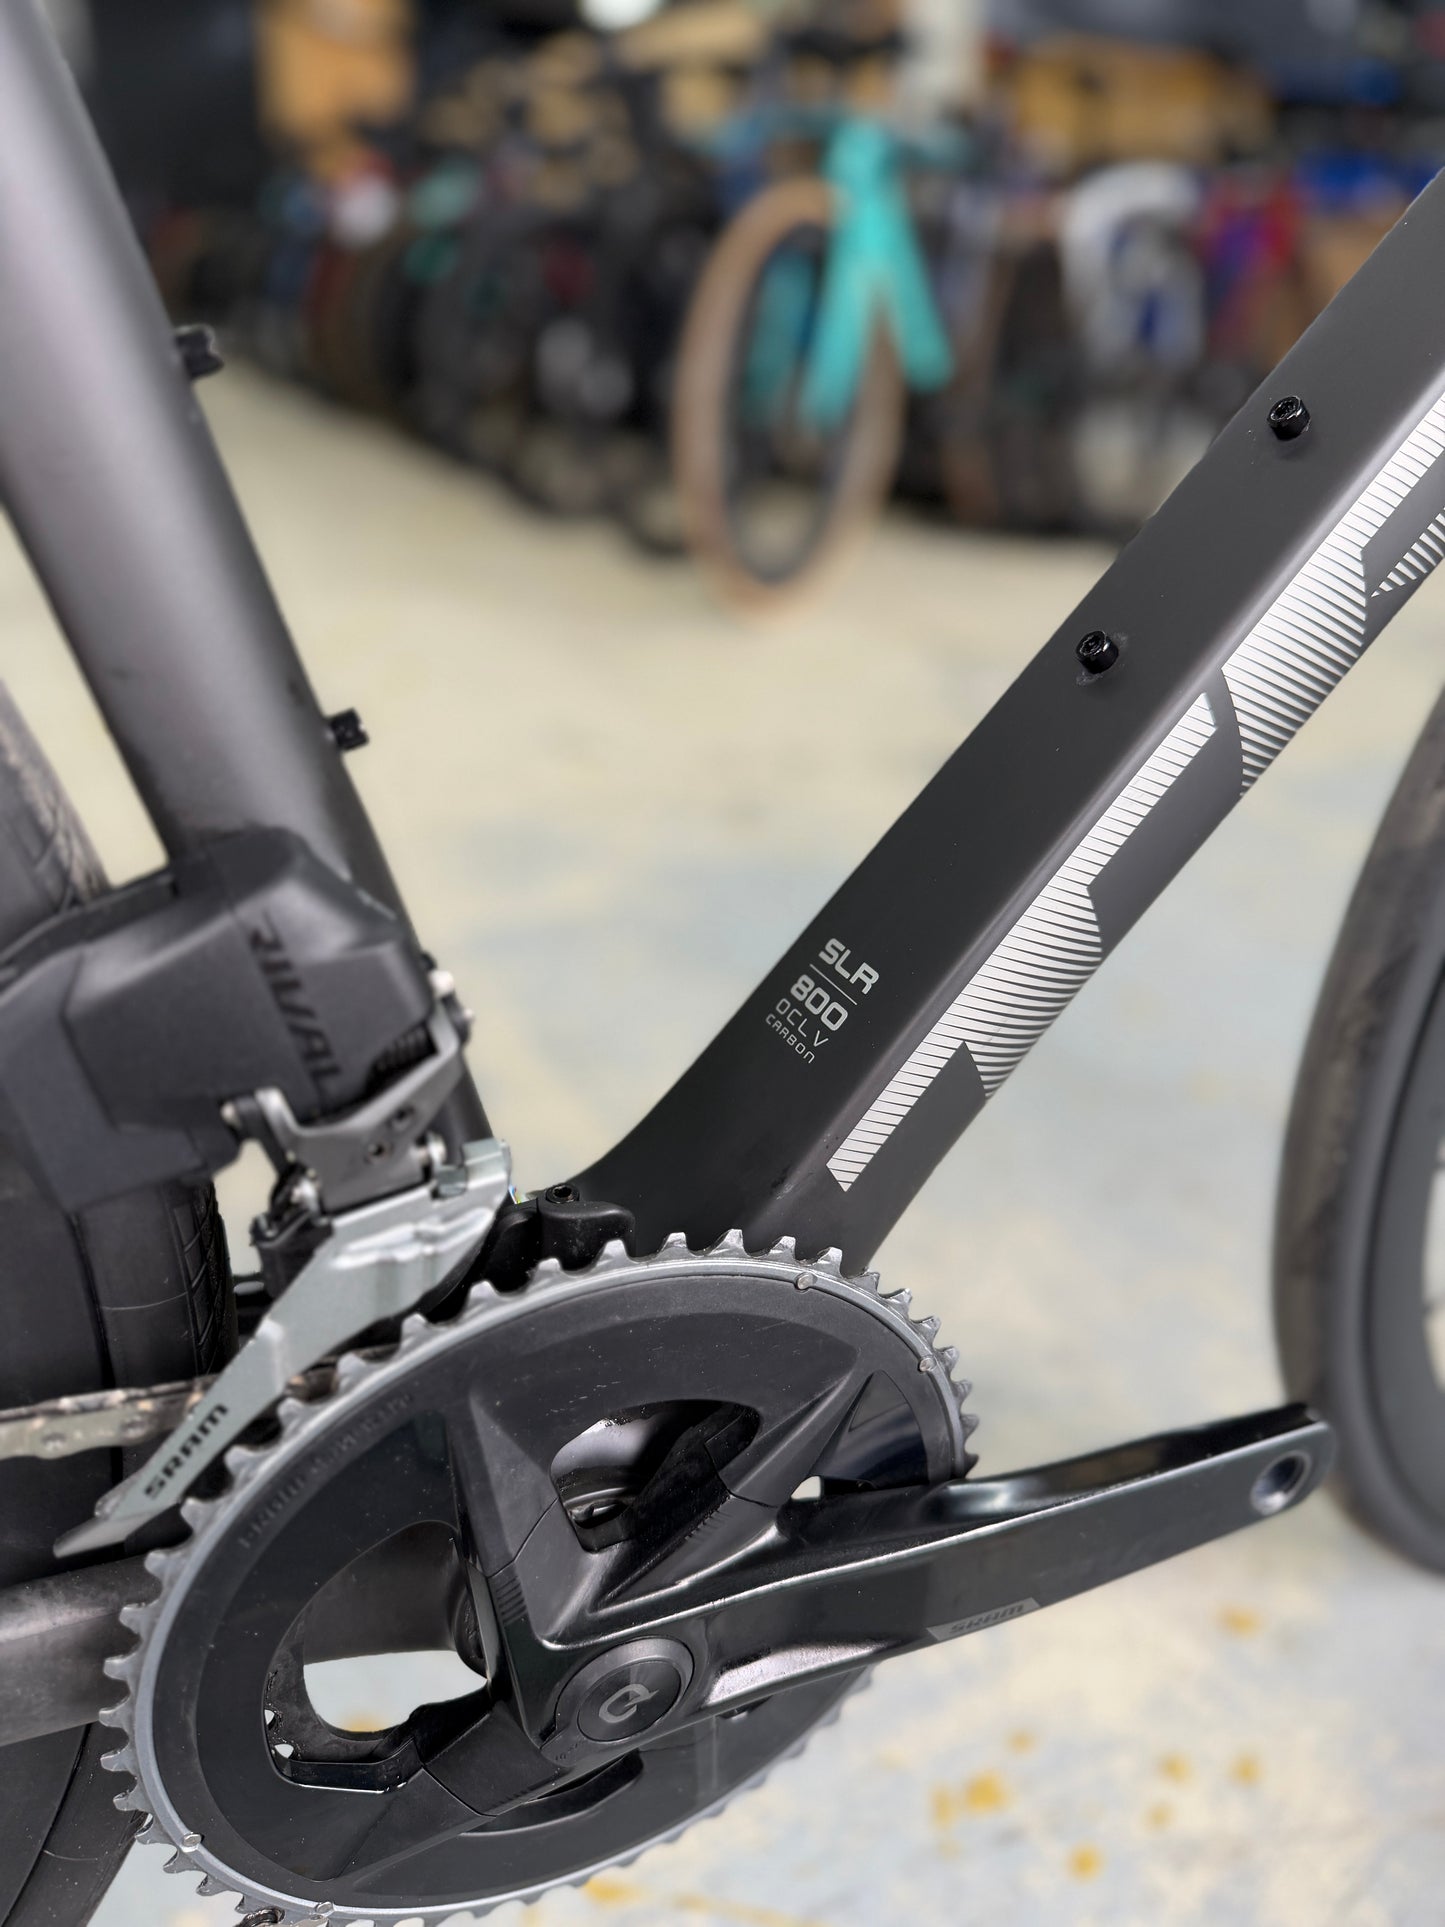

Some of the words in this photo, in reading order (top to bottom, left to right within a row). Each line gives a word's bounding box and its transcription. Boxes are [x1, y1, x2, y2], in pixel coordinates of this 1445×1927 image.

[818, 938, 880, 995] SLR
[790, 974, 848, 1031] 800
[765, 1013, 815, 1063] CARBON
[145, 1404, 229, 1500] SRAM
[950, 1605, 1024, 1632] SRAM
